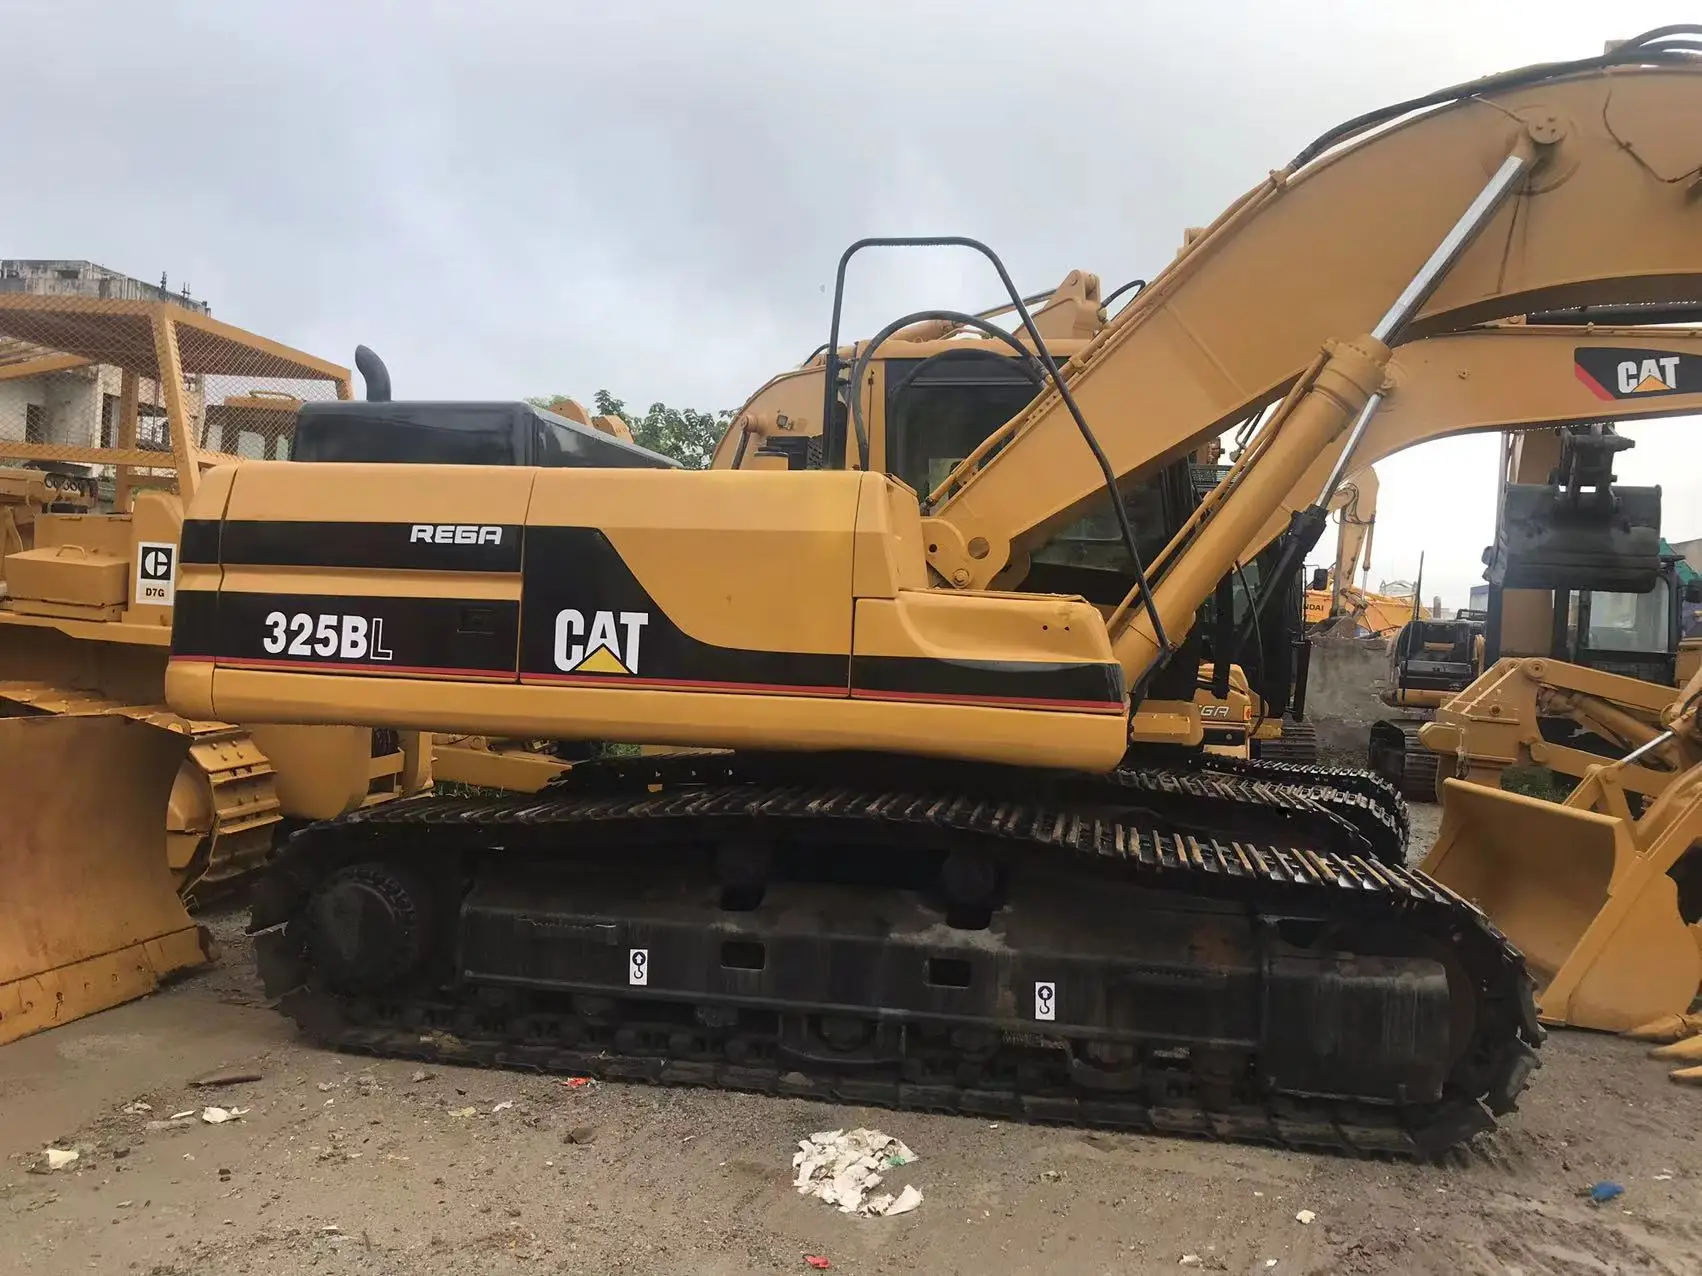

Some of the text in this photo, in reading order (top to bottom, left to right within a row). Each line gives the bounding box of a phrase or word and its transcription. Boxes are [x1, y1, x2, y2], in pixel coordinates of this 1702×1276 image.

[1617, 357, 1680, 393] CAT
[410, 524, 502, 544] REGA
[145, 588, 165, 597] D7G
[554, 608, 649, 675] CAT
[1199, 704, 1230, 717] GA
